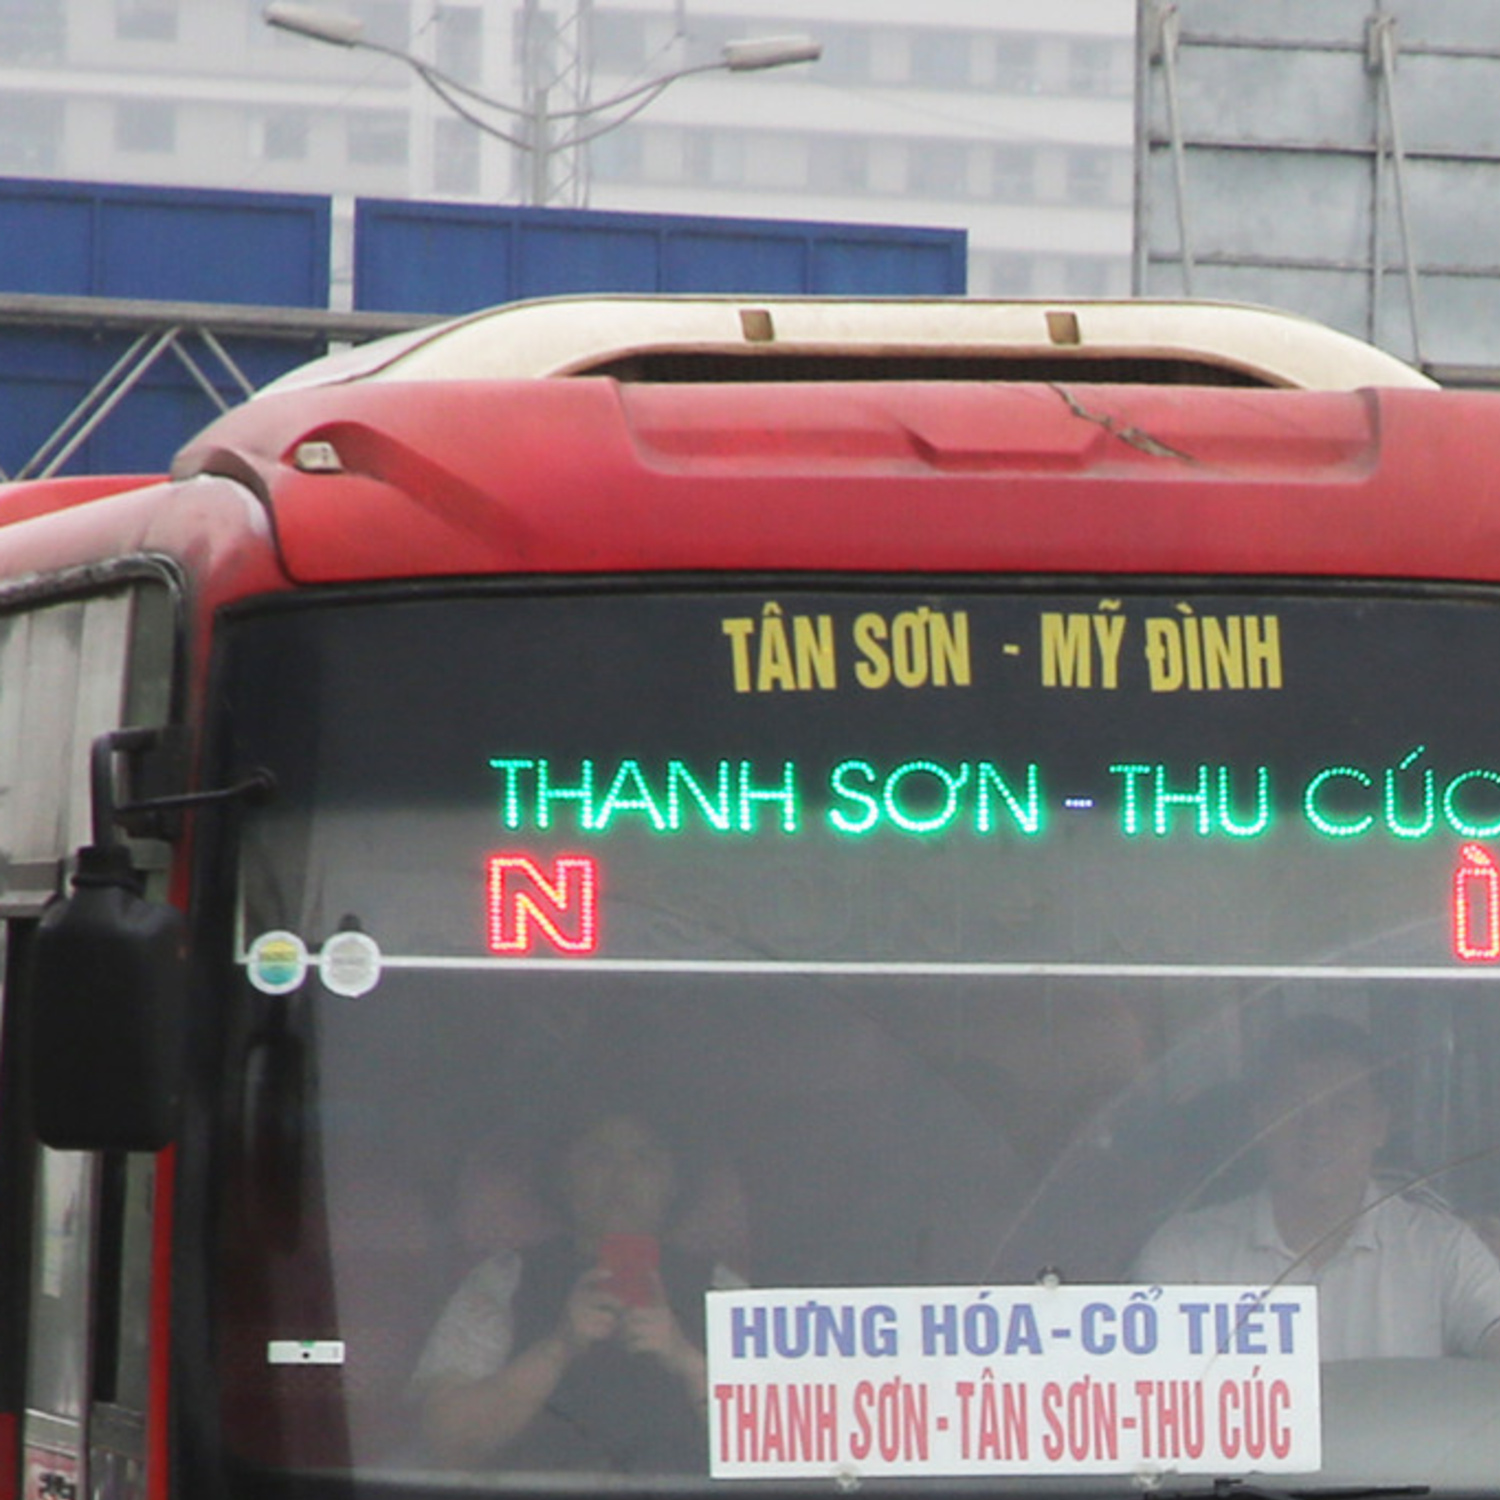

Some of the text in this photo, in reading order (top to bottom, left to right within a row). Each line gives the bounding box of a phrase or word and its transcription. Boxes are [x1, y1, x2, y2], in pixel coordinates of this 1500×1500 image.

[722, 601, 837, 693] TÂN
[853, 606, 971, 689] SƠN
[1040, 599, 1126, 689] MỸ
[1145, 601, 1282, 692] ĐÌNH
[488, 758, 797, 833] THANH
[829, 759, 1039, 833] SƠN
[1109, 763, 1267, 836] THU
[488, 855, 595, 952] N
[731, 1300, 898, 1358] HƯNG
[1179, 1290, 1300, 1355] TIẾT
[714, 1383, 838, 1463] THANH
[1218, 1365, 1292, 1460] CÚC
